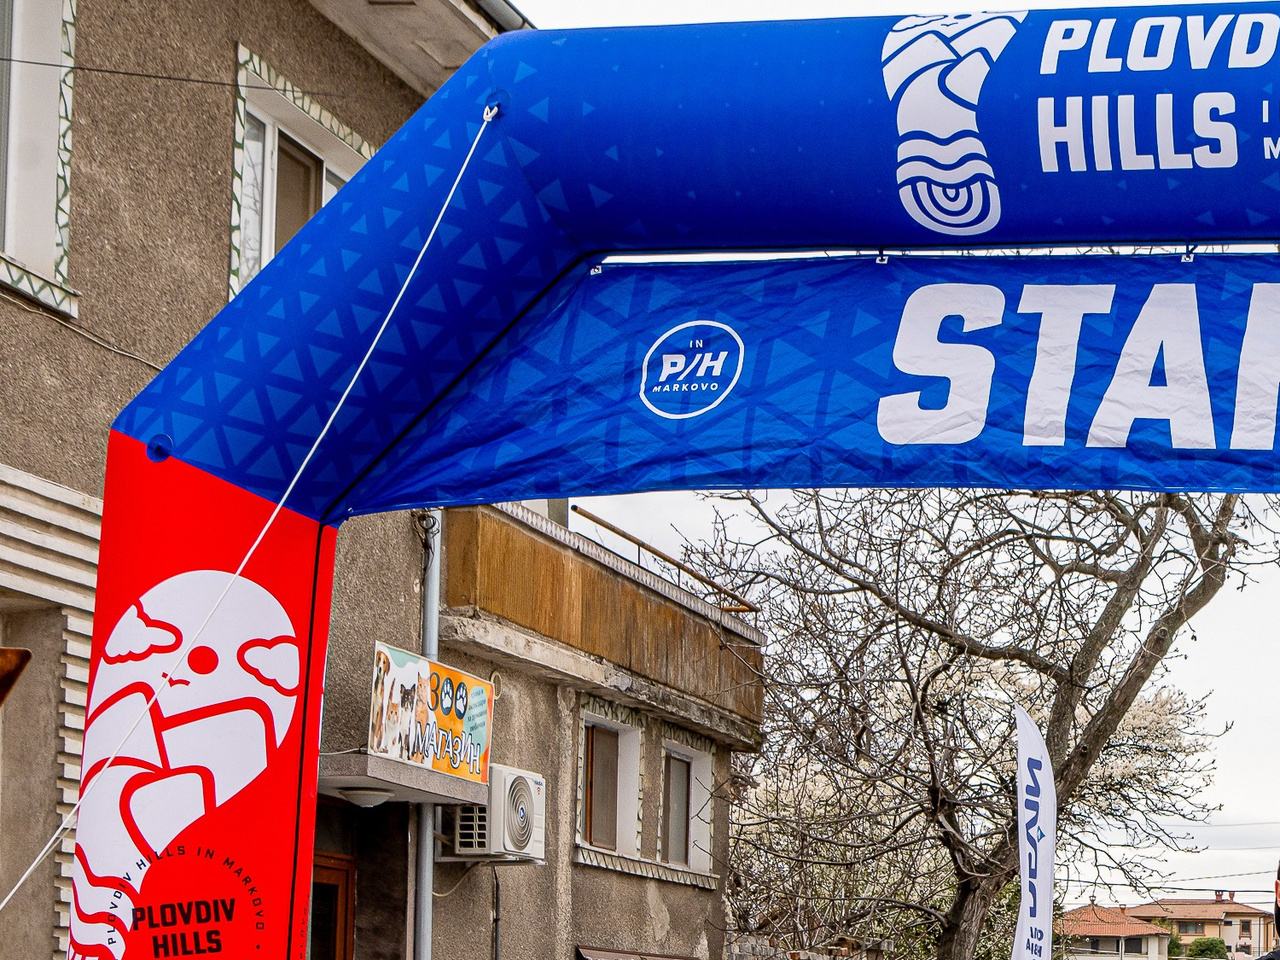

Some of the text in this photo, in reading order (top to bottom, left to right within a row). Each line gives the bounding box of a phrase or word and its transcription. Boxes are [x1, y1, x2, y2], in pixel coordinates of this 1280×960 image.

[1037, 91, 1239, 173] HILLS
[689, 339, 703, 348] IN
[659, 351, 729, 382] P/H
[652, 382, 719, 393] MARKOVO
[414, 721, 481, 775] МАГАЗИН
[107, 872, 132, 945] PLOVDIV
[136, 845, 185, 870] HILLS
[197, 846, 215, 860] IN
[223, 857, 265, 930] MARKOVO
[132, 898, 236, 931] PLOVDIV
[152, 929, 222, 958] HILLS
